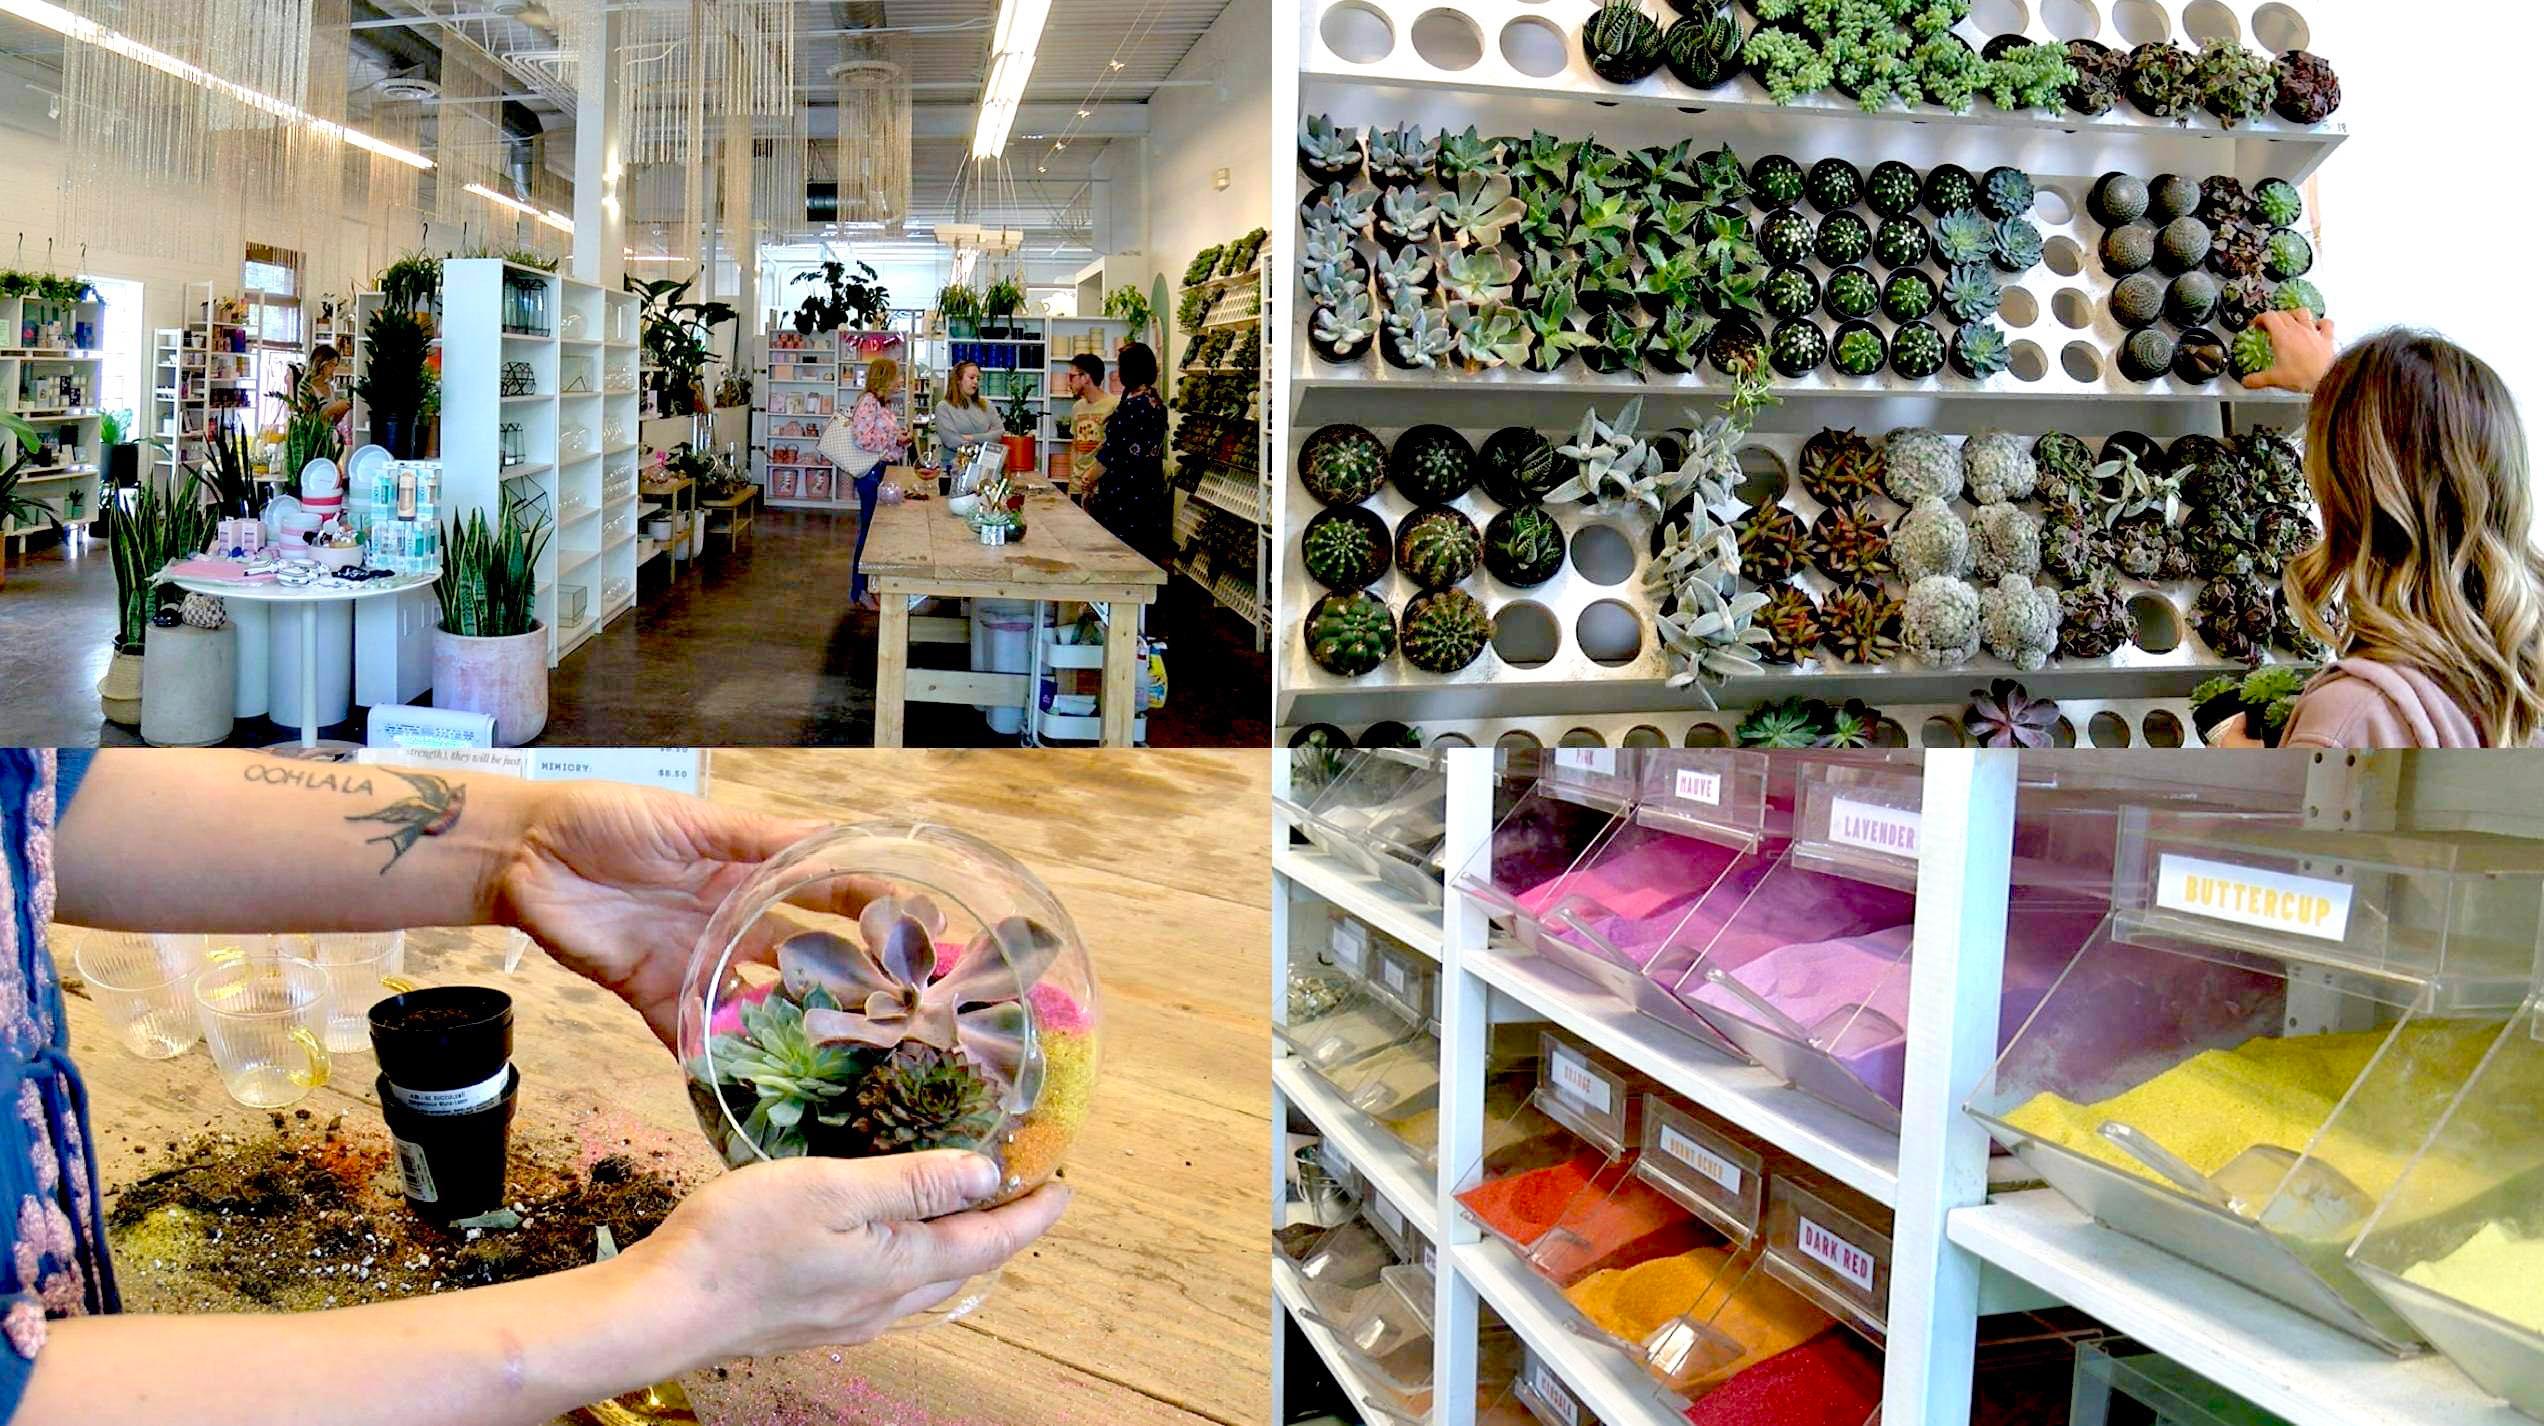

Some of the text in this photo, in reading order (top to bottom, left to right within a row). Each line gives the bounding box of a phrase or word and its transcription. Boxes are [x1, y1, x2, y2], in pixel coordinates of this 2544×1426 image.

[451, 750, 470, 764] they
[472, 752, 490, 763] will
[491, 753, 501, 764] be
[1576, 748, 1594, 766] PINK
[1680, 775, 1712, 798] MAUVE
[1844, 815, 1916, 849] LAVENDER
[2185, 874, 2331, 927] BUTTERCUP
[1805, 1225, 1868, 1279] DARK RED
